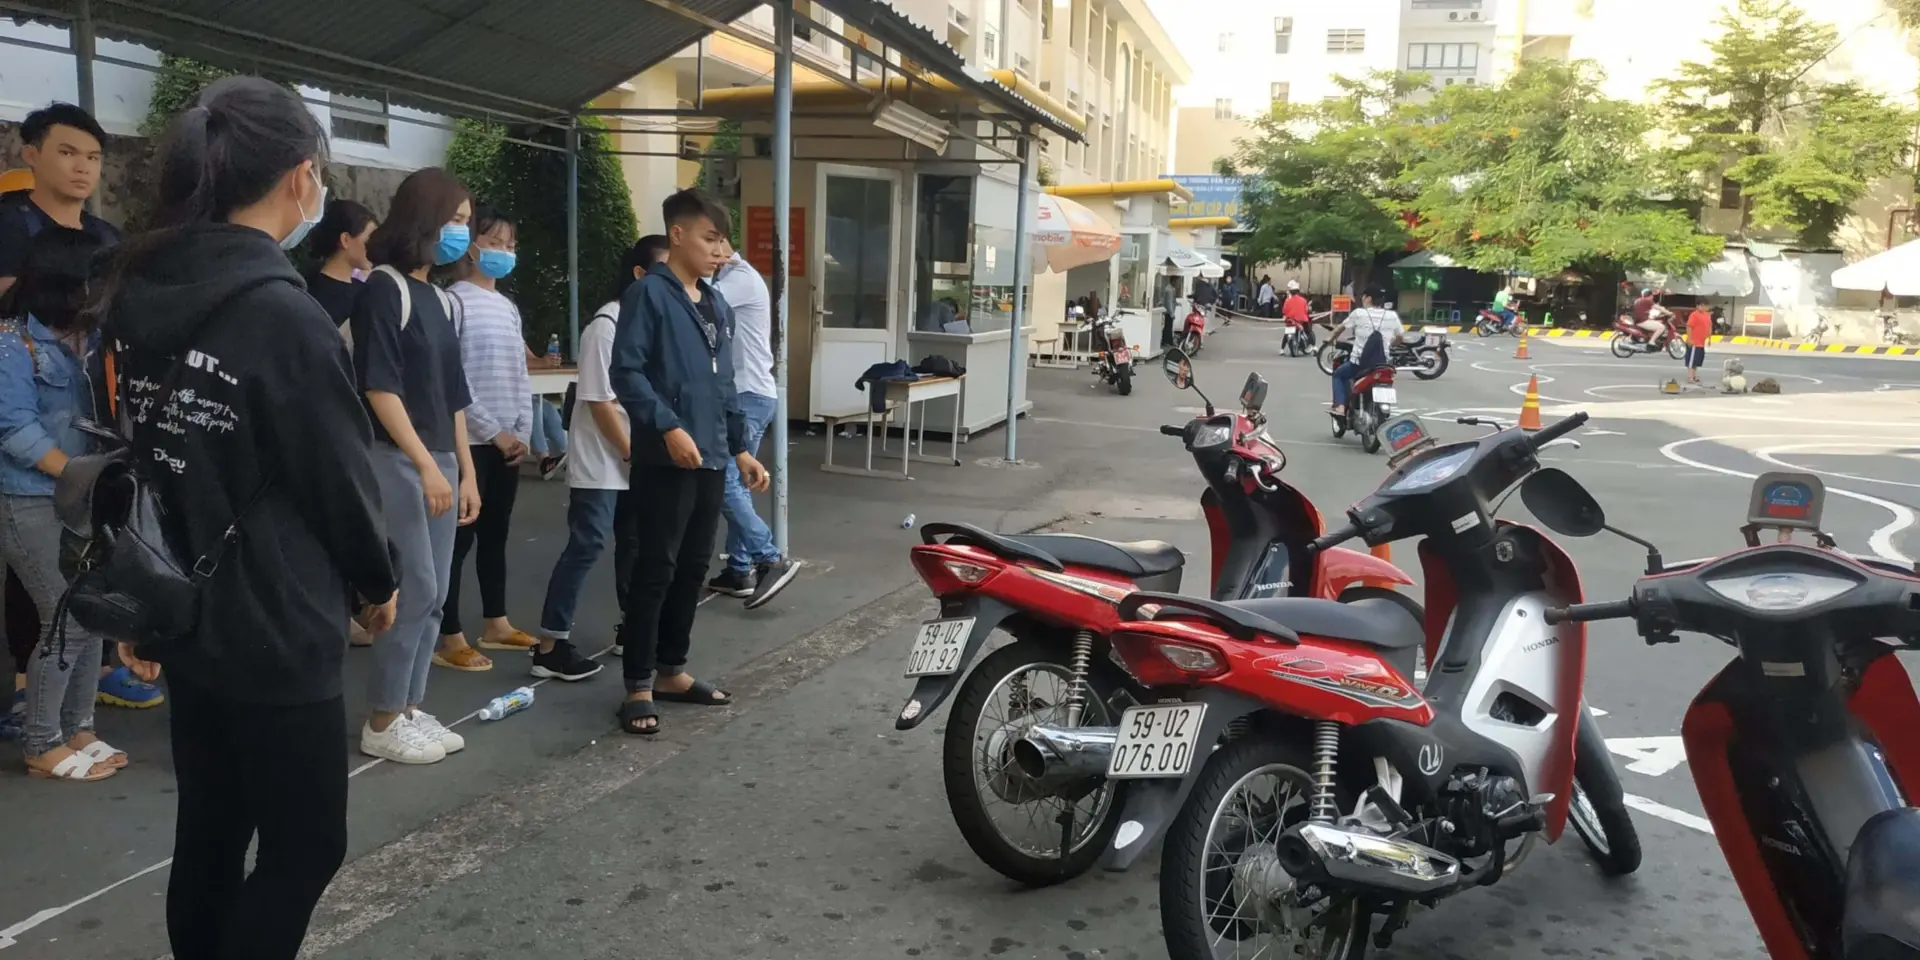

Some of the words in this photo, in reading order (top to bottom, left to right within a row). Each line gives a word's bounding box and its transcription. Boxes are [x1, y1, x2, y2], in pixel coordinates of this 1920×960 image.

[1257, 581, 1294, 591] HONDA
[922, 623, 963, 646] 59-U2
[1522, 636, 1560, 653] HONDA
[908, 648, 958, 672] 001.92
[1130, 709, 1190, 739] 59-U2
[1113, 742, 1187, 772] 076.00
